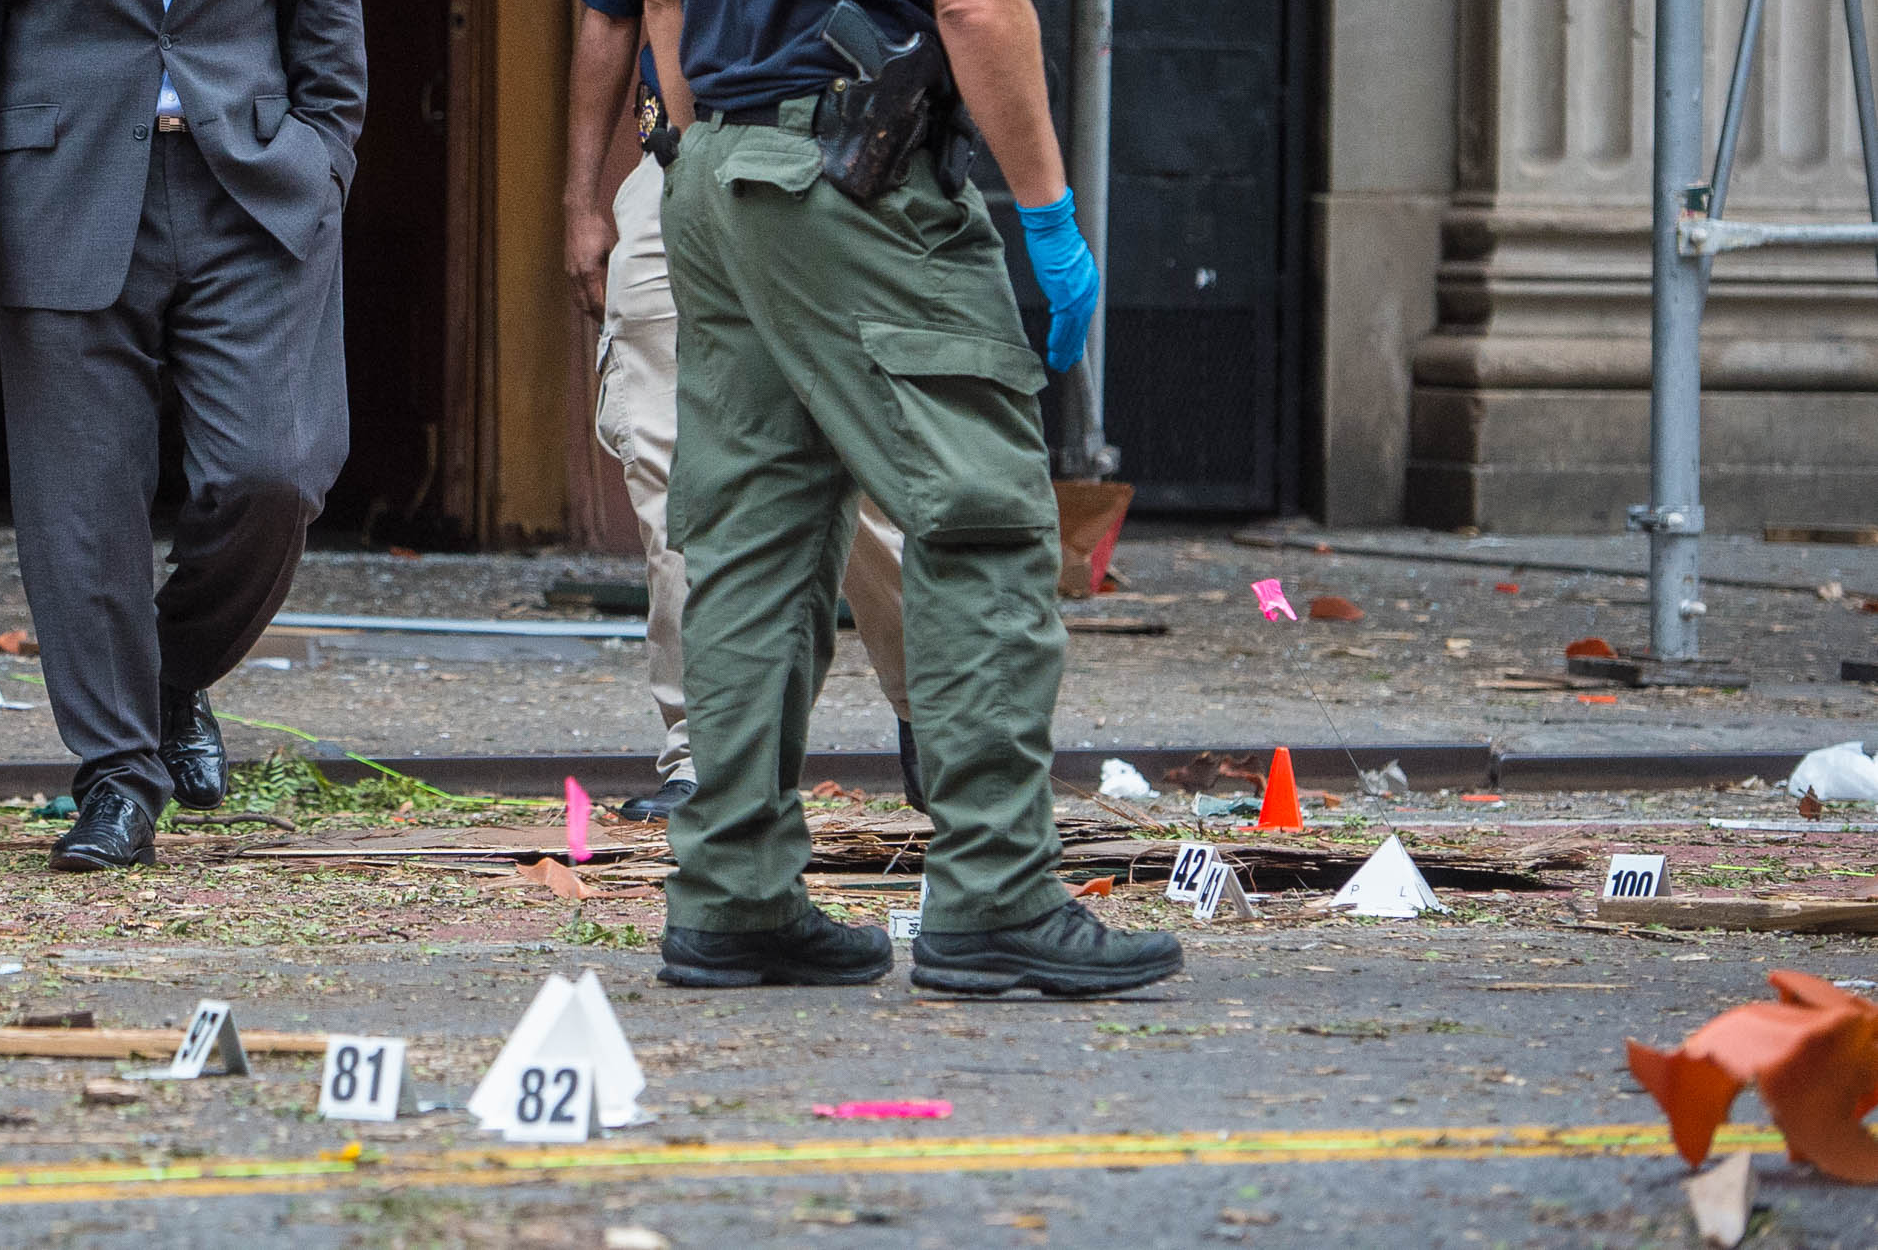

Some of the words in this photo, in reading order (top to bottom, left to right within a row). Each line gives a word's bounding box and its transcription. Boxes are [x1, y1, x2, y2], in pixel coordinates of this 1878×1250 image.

[1173, 848, 1207, 891] 42
[1200, 867, 1224, 912] 41
[1612, 869, 1654, 897] 100
[330, 1046, 385, 1104] 81
[516, 1067, 578, 1125] 82
